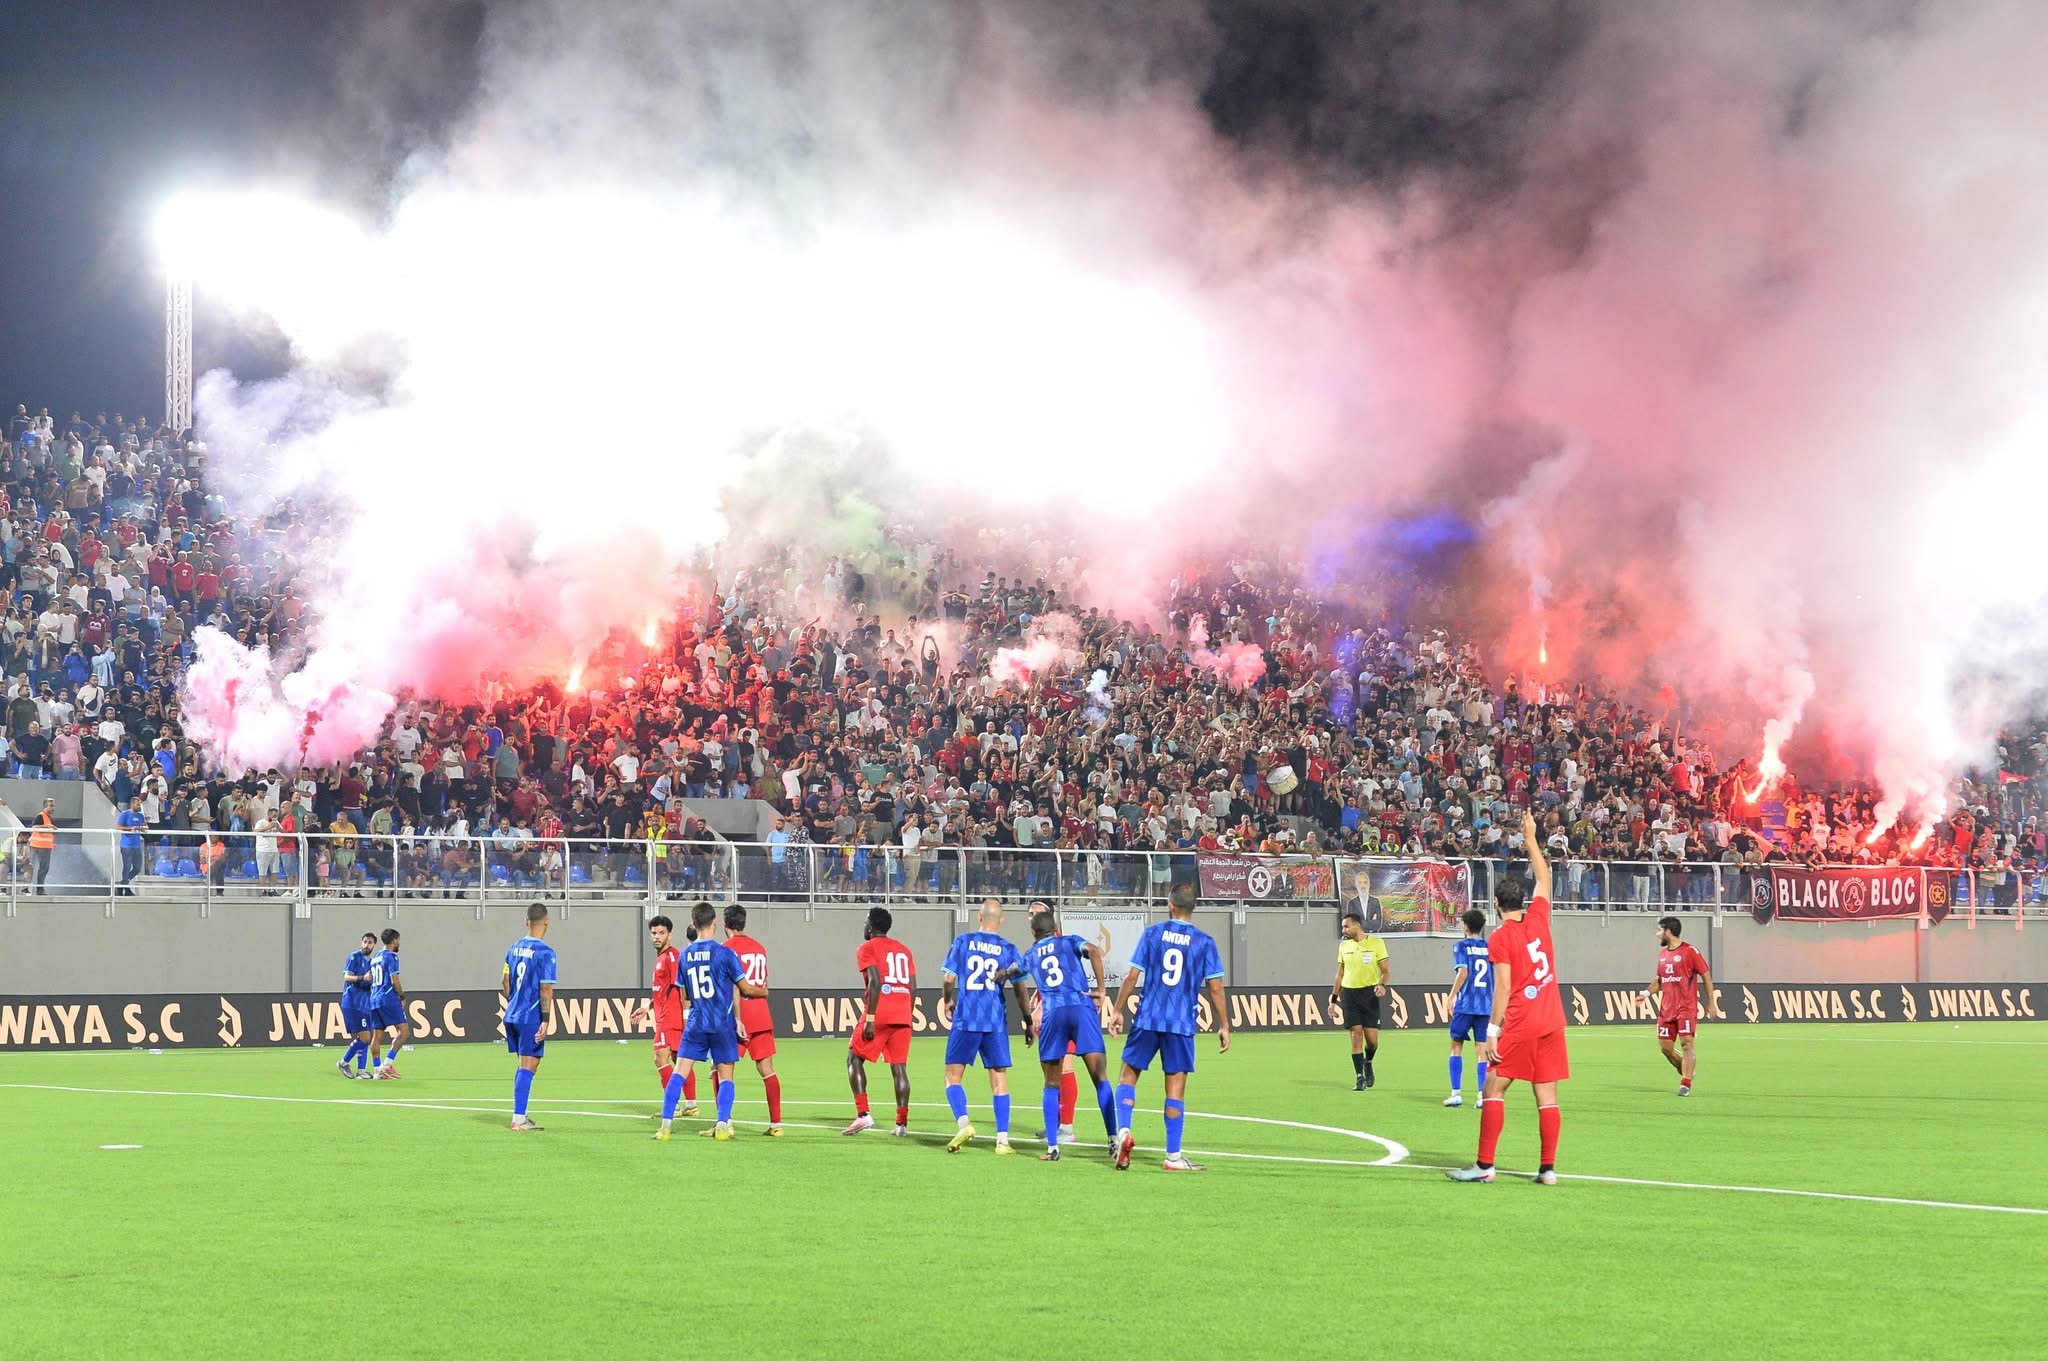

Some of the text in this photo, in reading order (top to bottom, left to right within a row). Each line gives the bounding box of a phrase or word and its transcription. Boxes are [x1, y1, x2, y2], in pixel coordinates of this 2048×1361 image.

[1779, 878, 1840, 908] BLACK
[1871, 877, 1915, 906] BLOC
[1037, 942, 1055, 957] ITO
[1162, 930, 1191, 946] ANTAR
[741, 953, 768, 986] 20
[884, 951, 910, 985] 10
[966, 955, 999, 991] 23
[1040, 955, 1064, 988] 3
[1161, 948, 1184, 986] 9
[1474, 959, 1488, 988] 2
[1527, 938, 1551, 980] 5
[1665, 963, 1674, 974] 21
[516, 961, 527, 991] 8
[687, 965, 715, 1000] 15
[409, 1000, 466, 1038] S.C
[1231, 994, 1324, 1028] JWAYA
[1771, 990, 1886, 1019] JWAYA S.C
[1929, 989, 2035, 1018] JWAYA S.C
[123, 1003, 184, 1043] S.C
[361, 1018, 367, 1028] 6
[1660, 1027, 1669, 1037] 21
